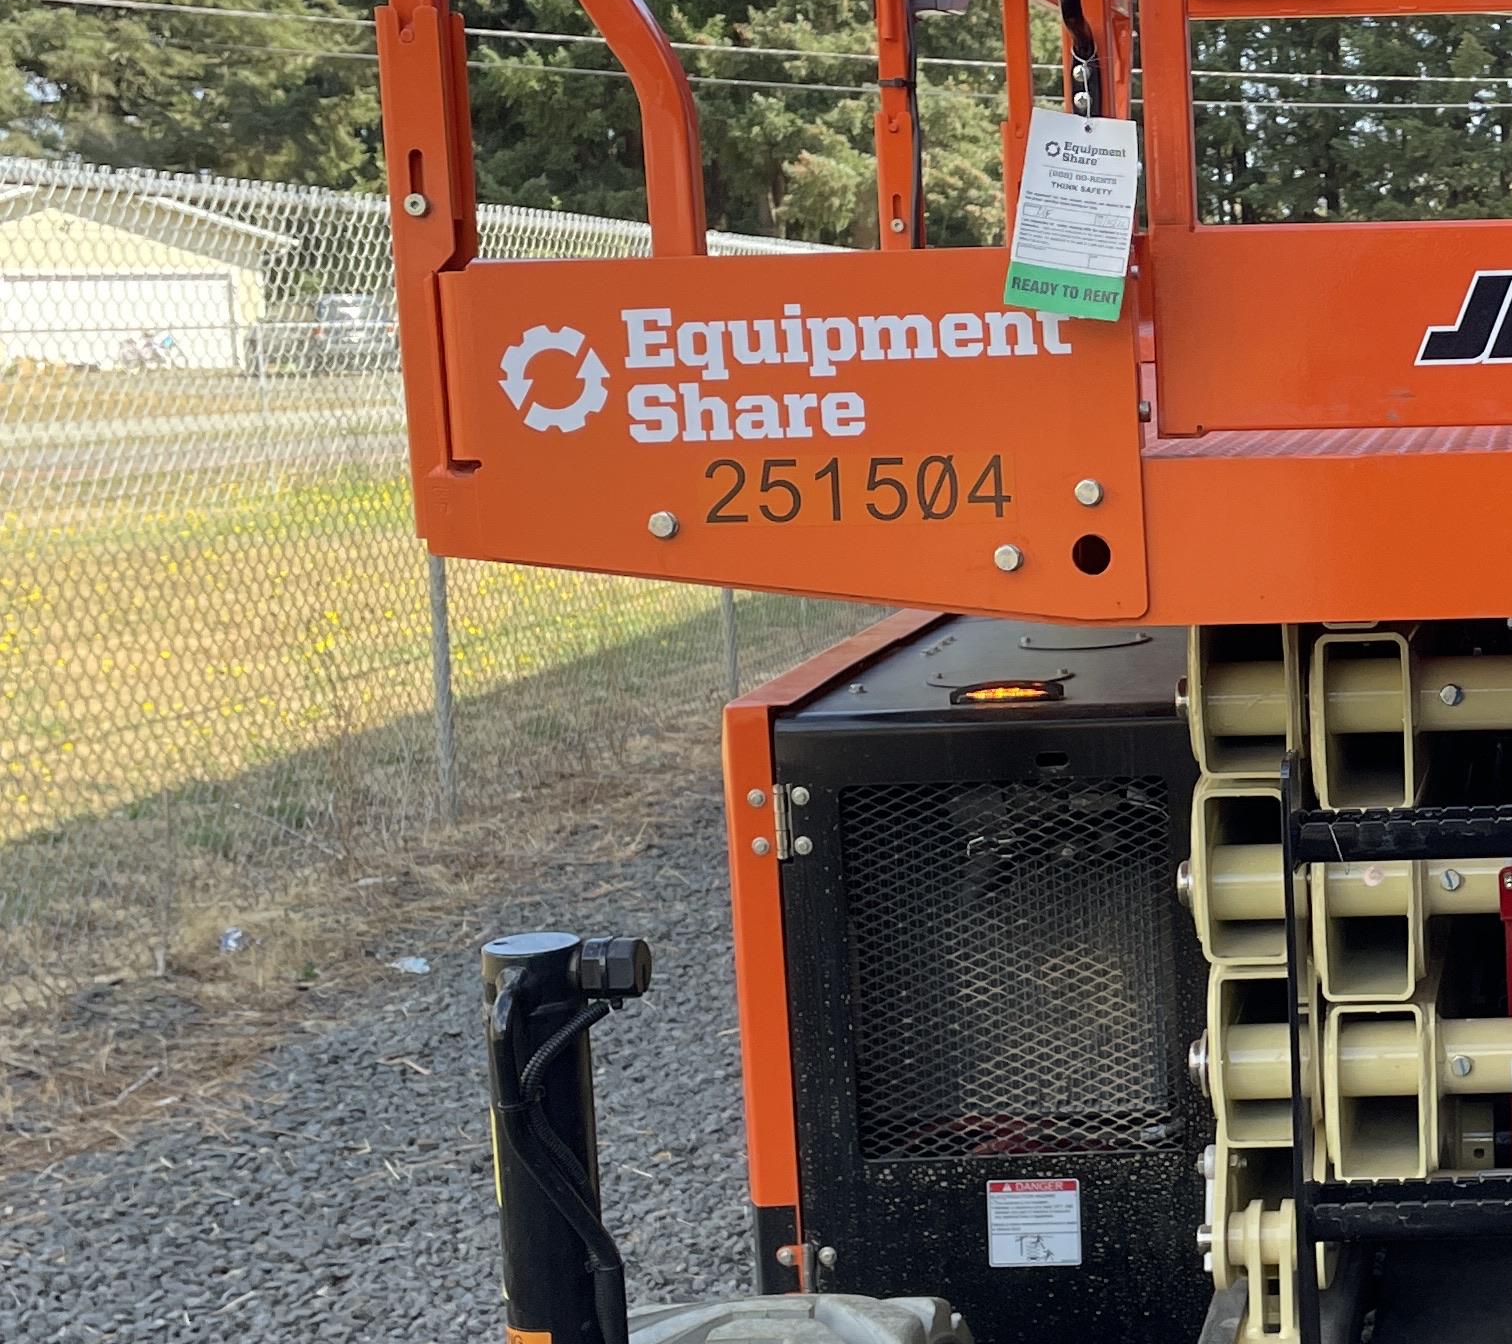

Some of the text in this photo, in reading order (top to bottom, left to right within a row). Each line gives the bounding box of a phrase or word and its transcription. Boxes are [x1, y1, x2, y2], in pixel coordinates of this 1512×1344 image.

[1062, 152, 1098, 166] Share
[1063, 141, 1126, 158] Equipment
[1051, 181, 1113, 196] THINK SAFETY
[1011, 276, 1120, 305] READY TO RENT
[621, 303, 1073, 380] Equipment
[627, 382, 866, 443] Share
[705, 455, 1012, 524] 251504
[1015, 1182, 1064, 1191] DANGER
